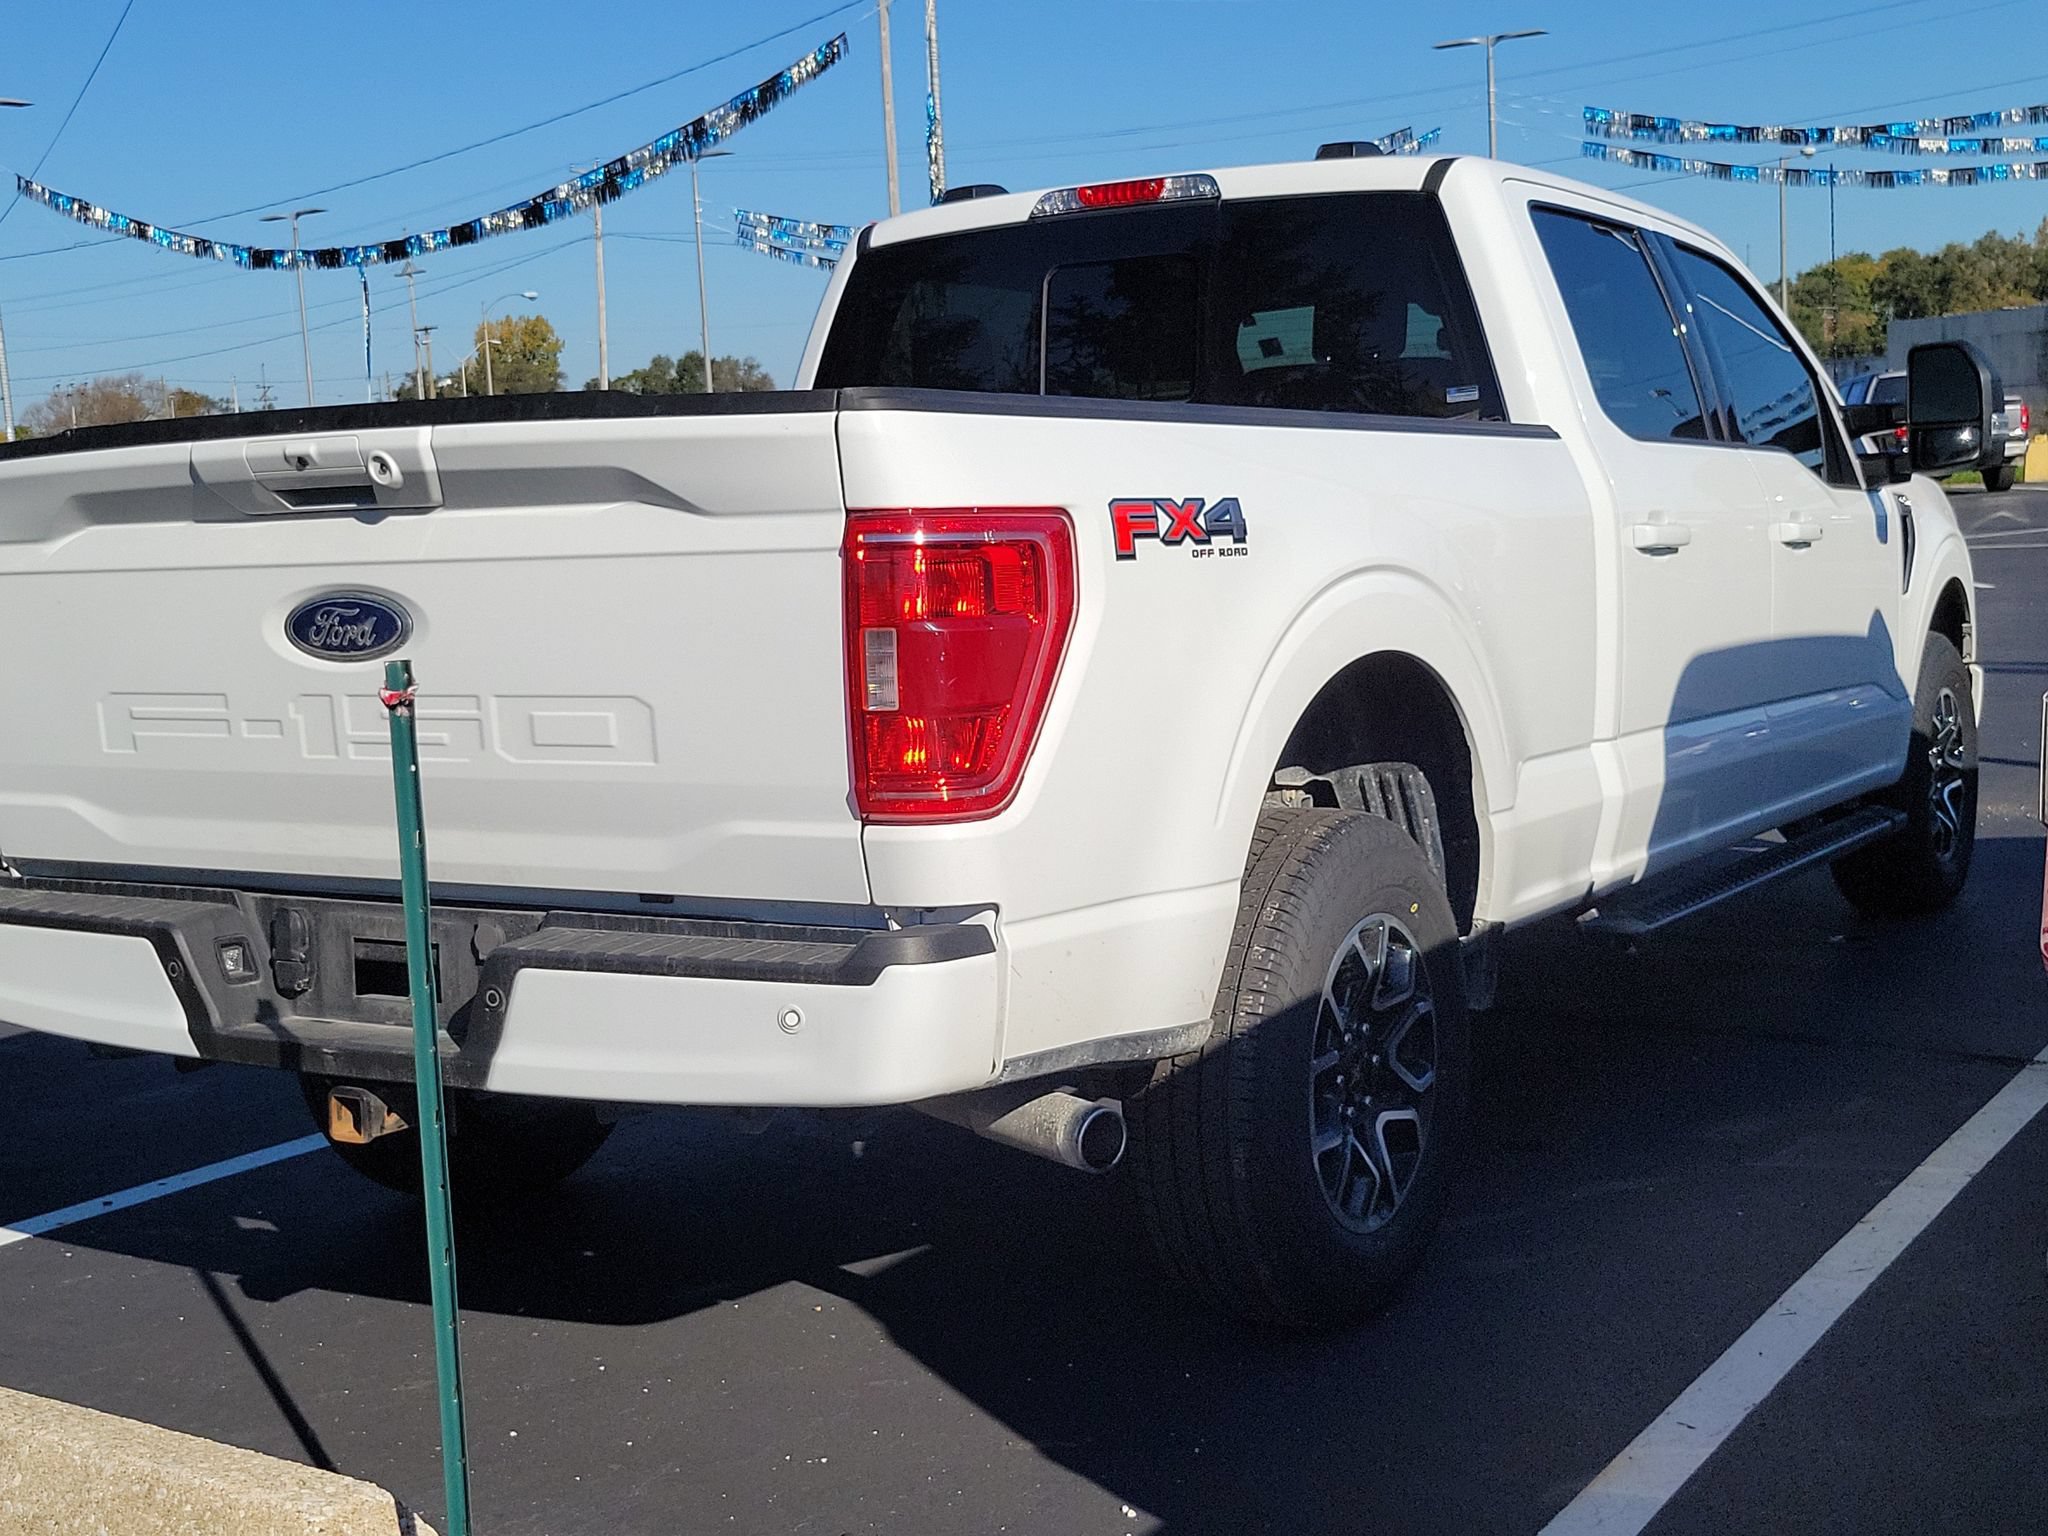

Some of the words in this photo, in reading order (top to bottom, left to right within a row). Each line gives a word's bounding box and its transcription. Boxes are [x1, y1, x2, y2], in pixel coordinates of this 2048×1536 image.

[1108, 498, 1248, 561] FX4
[1192, 549, 1215, 558] OFF
[1219, 547, 1248, 557] ROAD
[309, 606, 378, 646] Ford
[97, 691, 659, 766] F-150
